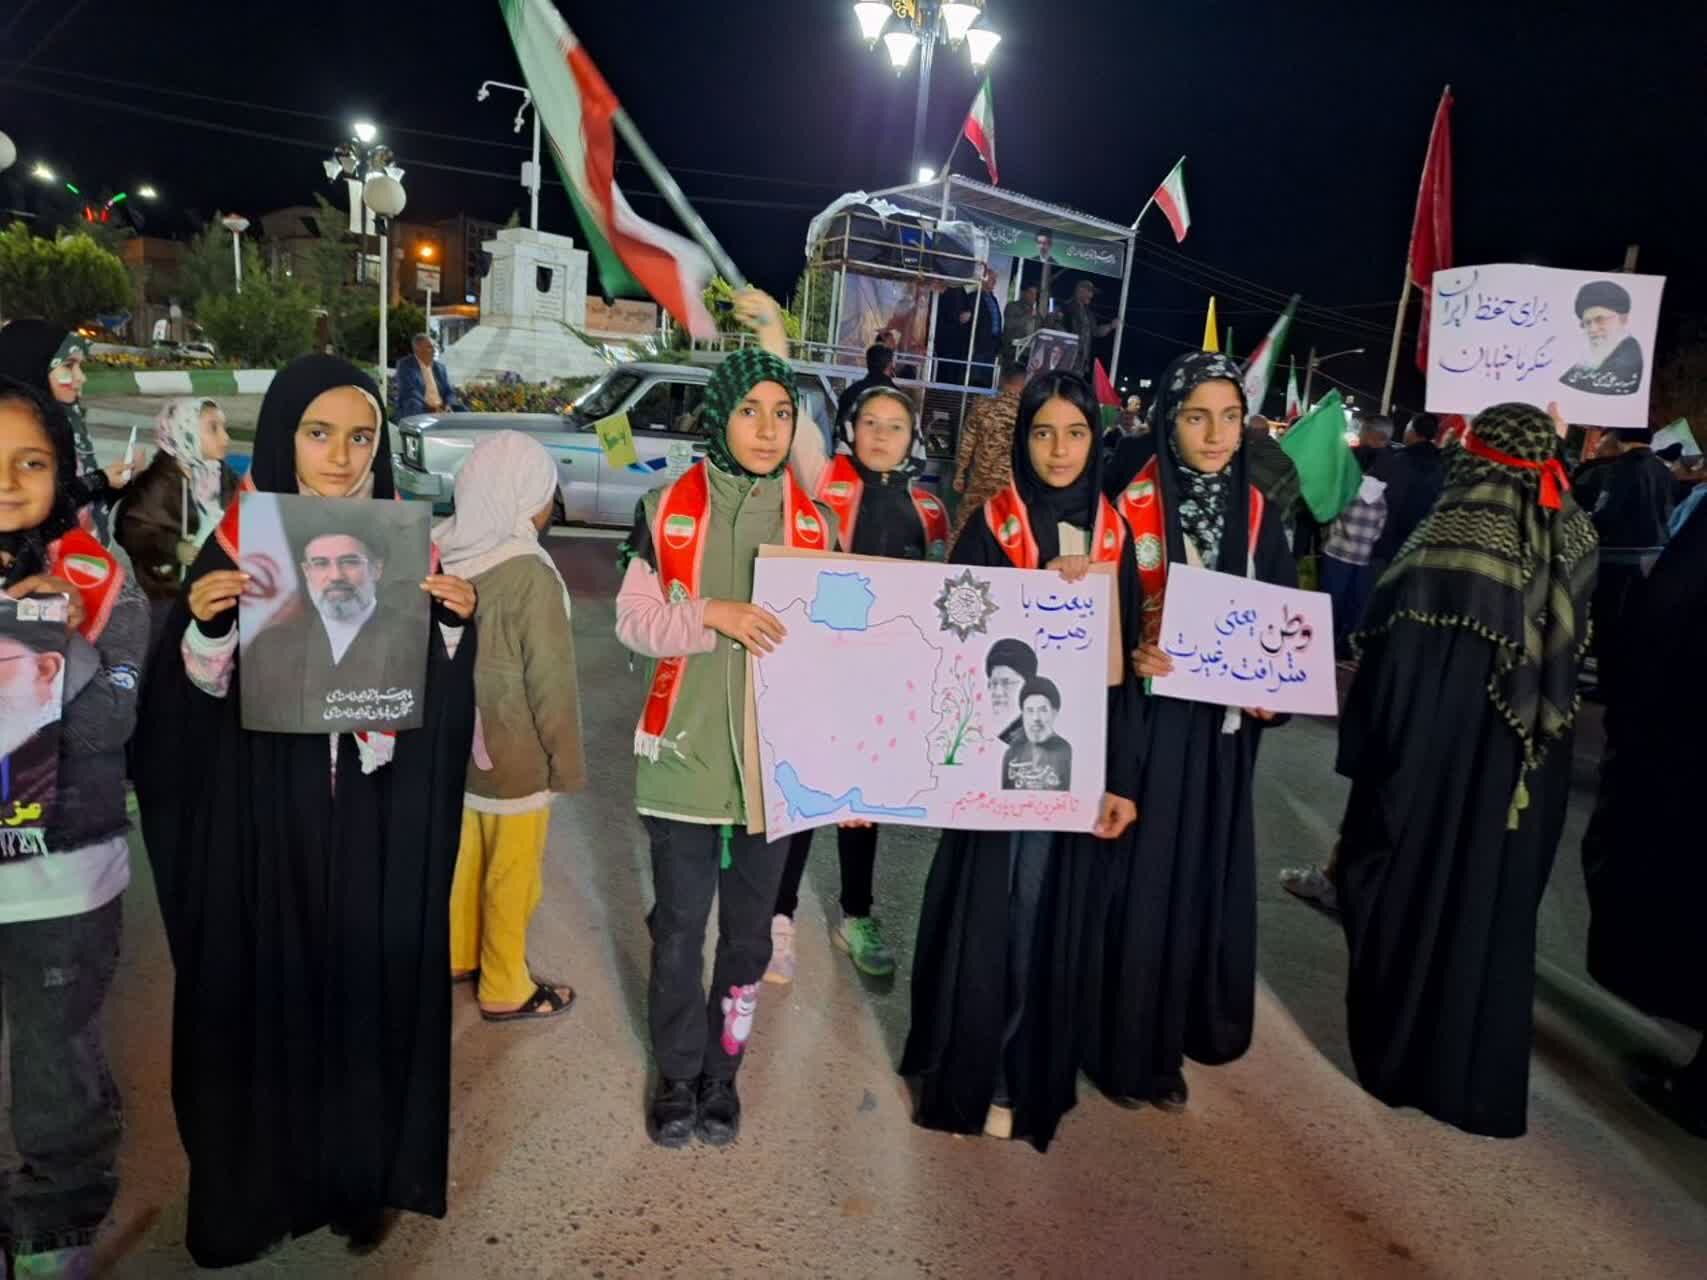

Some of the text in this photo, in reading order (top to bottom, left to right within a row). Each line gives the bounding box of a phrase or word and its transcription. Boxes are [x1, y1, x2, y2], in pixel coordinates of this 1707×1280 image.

[1439, 269, 1549, 328] برای حفظ ایران
[1439, 344, 1514, 380] خیابان
[1021, 584, 1095, 618] بیعت با
[1215, 600, 1257, 637] یعنی
[1034, 626, 1094, 651] رهبرم
[1261, 604, 1312, 654] وطن
[1165, 633, 1223, 674] غیرت
[1231, 651, 1307, 693] شرافت
